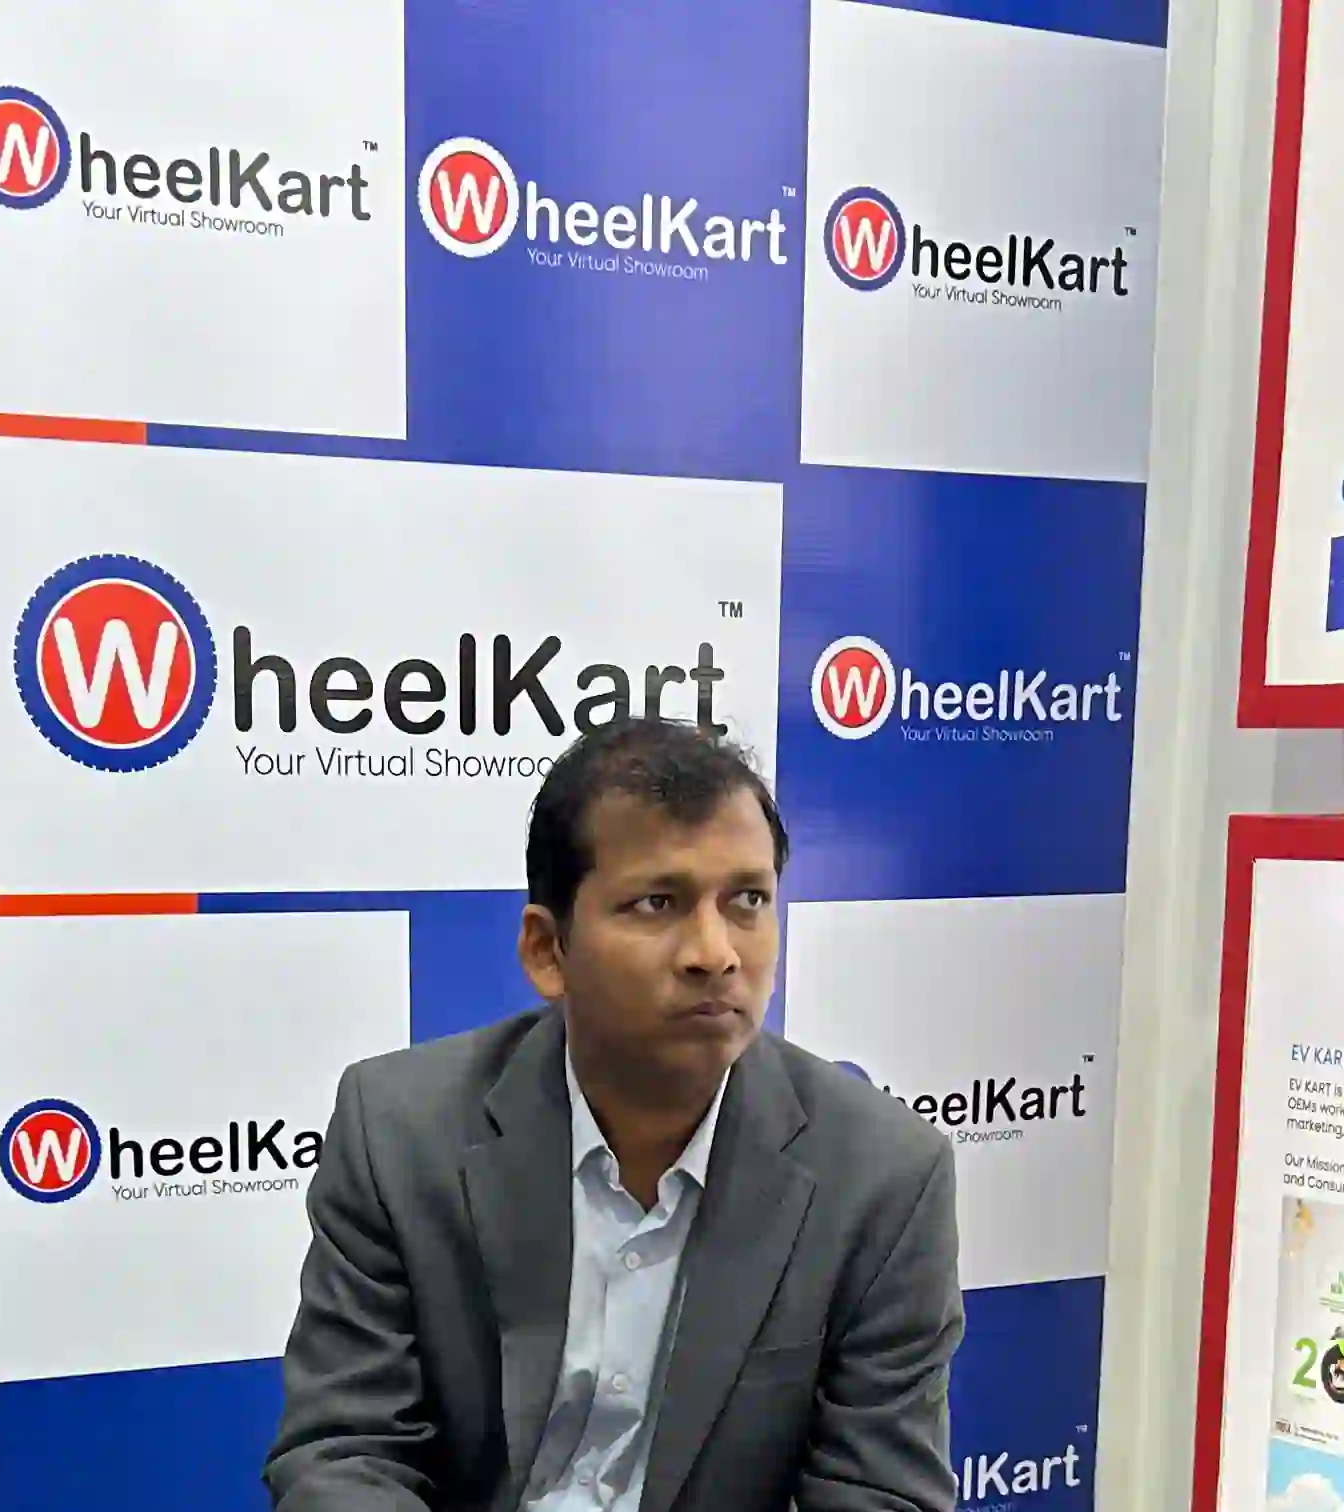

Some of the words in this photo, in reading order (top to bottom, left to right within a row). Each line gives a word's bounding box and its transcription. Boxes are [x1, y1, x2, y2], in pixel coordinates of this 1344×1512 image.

[82, 200, 121, 223] Your
[127, 204, 185, 229] Virtual
[190, 210, 284, 240] Showroom
[437, 166, 789, 267] WheelKart
[527, 246, 564, 271] Your
[567, 250, 619, 275] Virtual
[623, 258, 709, 283] Showroom
[839, 211, 1129, 298] WheelKart
[911, 282, 941, 303] Your
[944, 286, 988, 307] Virtual
[991, 291, 1063, 313] Showroom
[52, 615, 728, 739] WheelKart
[827, 664, 1123, 722] WheelKart
[901, 725, 932, 742] Your
[935, 726, 979, 742] Virtual
[982, 726, 1054, 742] Showroom
[236, 744, 306, 778] Your
[315, 744, 415, 778] Virtual
[424, 744, 554, 778] Showroo
[1291, 1043, 1310, 1063] EV
[883, 1073, 1086, 1126] eelKart
[1289, 1077, 1302, 1092] EV
[1304, 1080, 1332, 1098] KART
[1334, 1085, 1343, 1098] is
[17, 1119, 324, 1184] WheelKa
[956, 1129, 1024, 1144] Showroom
[1284, 1152, 1304, 1169] Our
[111, 1184, 149, 1201] Your
[153, 1182, 207, 1198] Virtual
[211, 1176, 300, 1195] Showroom
[1283, 1170, 1305, 1188] and
